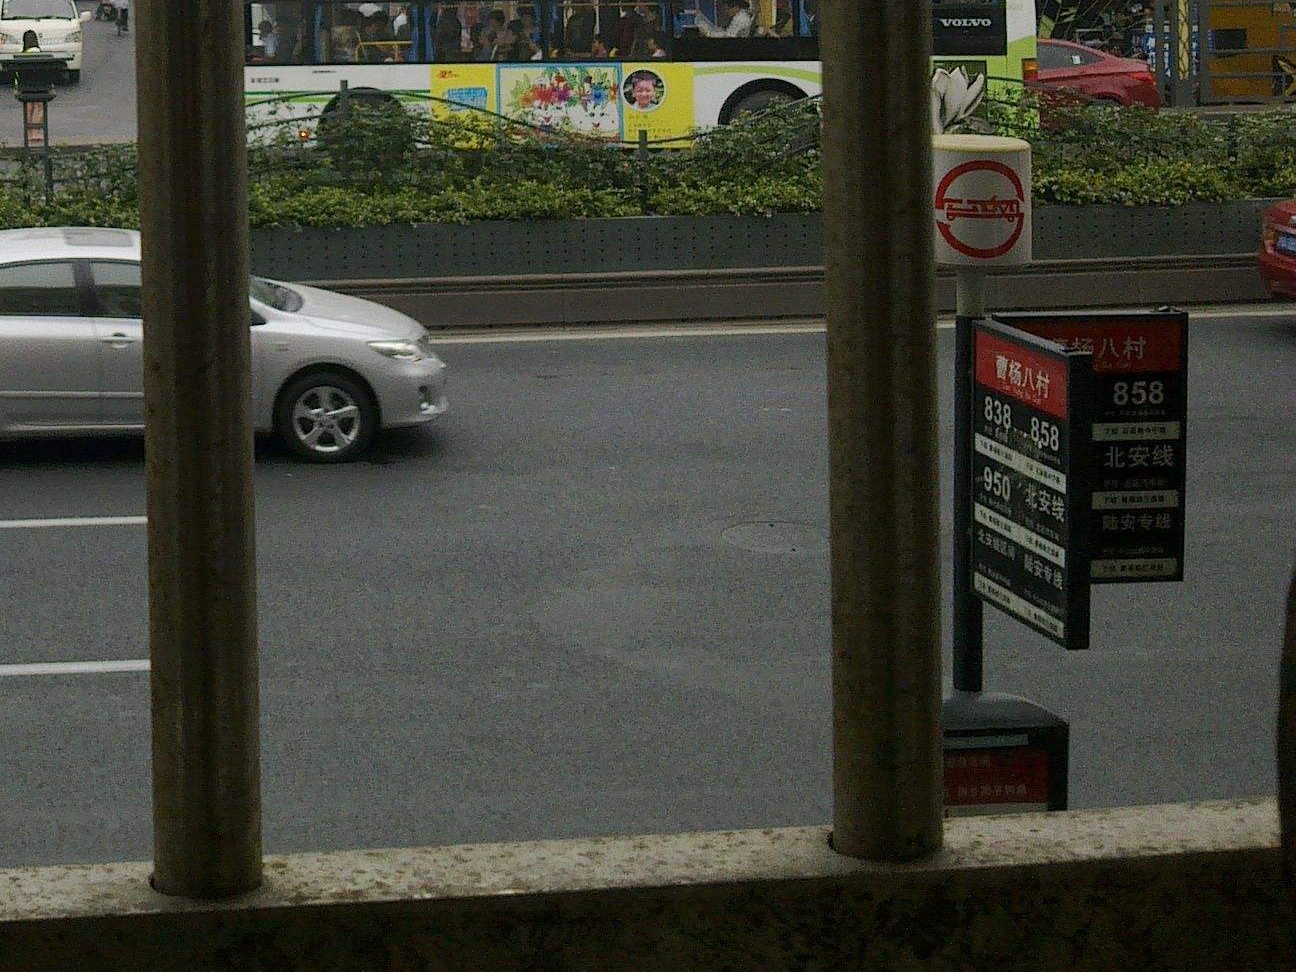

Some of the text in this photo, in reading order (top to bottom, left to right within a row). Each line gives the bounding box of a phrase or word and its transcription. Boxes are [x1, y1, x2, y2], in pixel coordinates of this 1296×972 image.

[940, 18, 992, 27] VOLVO
[995, 355, 1050, 399] 曹杨八村
[1113, 380, 1164, 406] 858
[984, 395, 1011, 430] 838
[1031, 416, 1060, 452] 858
[1103, 444, 1175, 469] 北安线
[983, 465, 1010, 501] 950
[1024, 484, 1065, 523] 北安线
